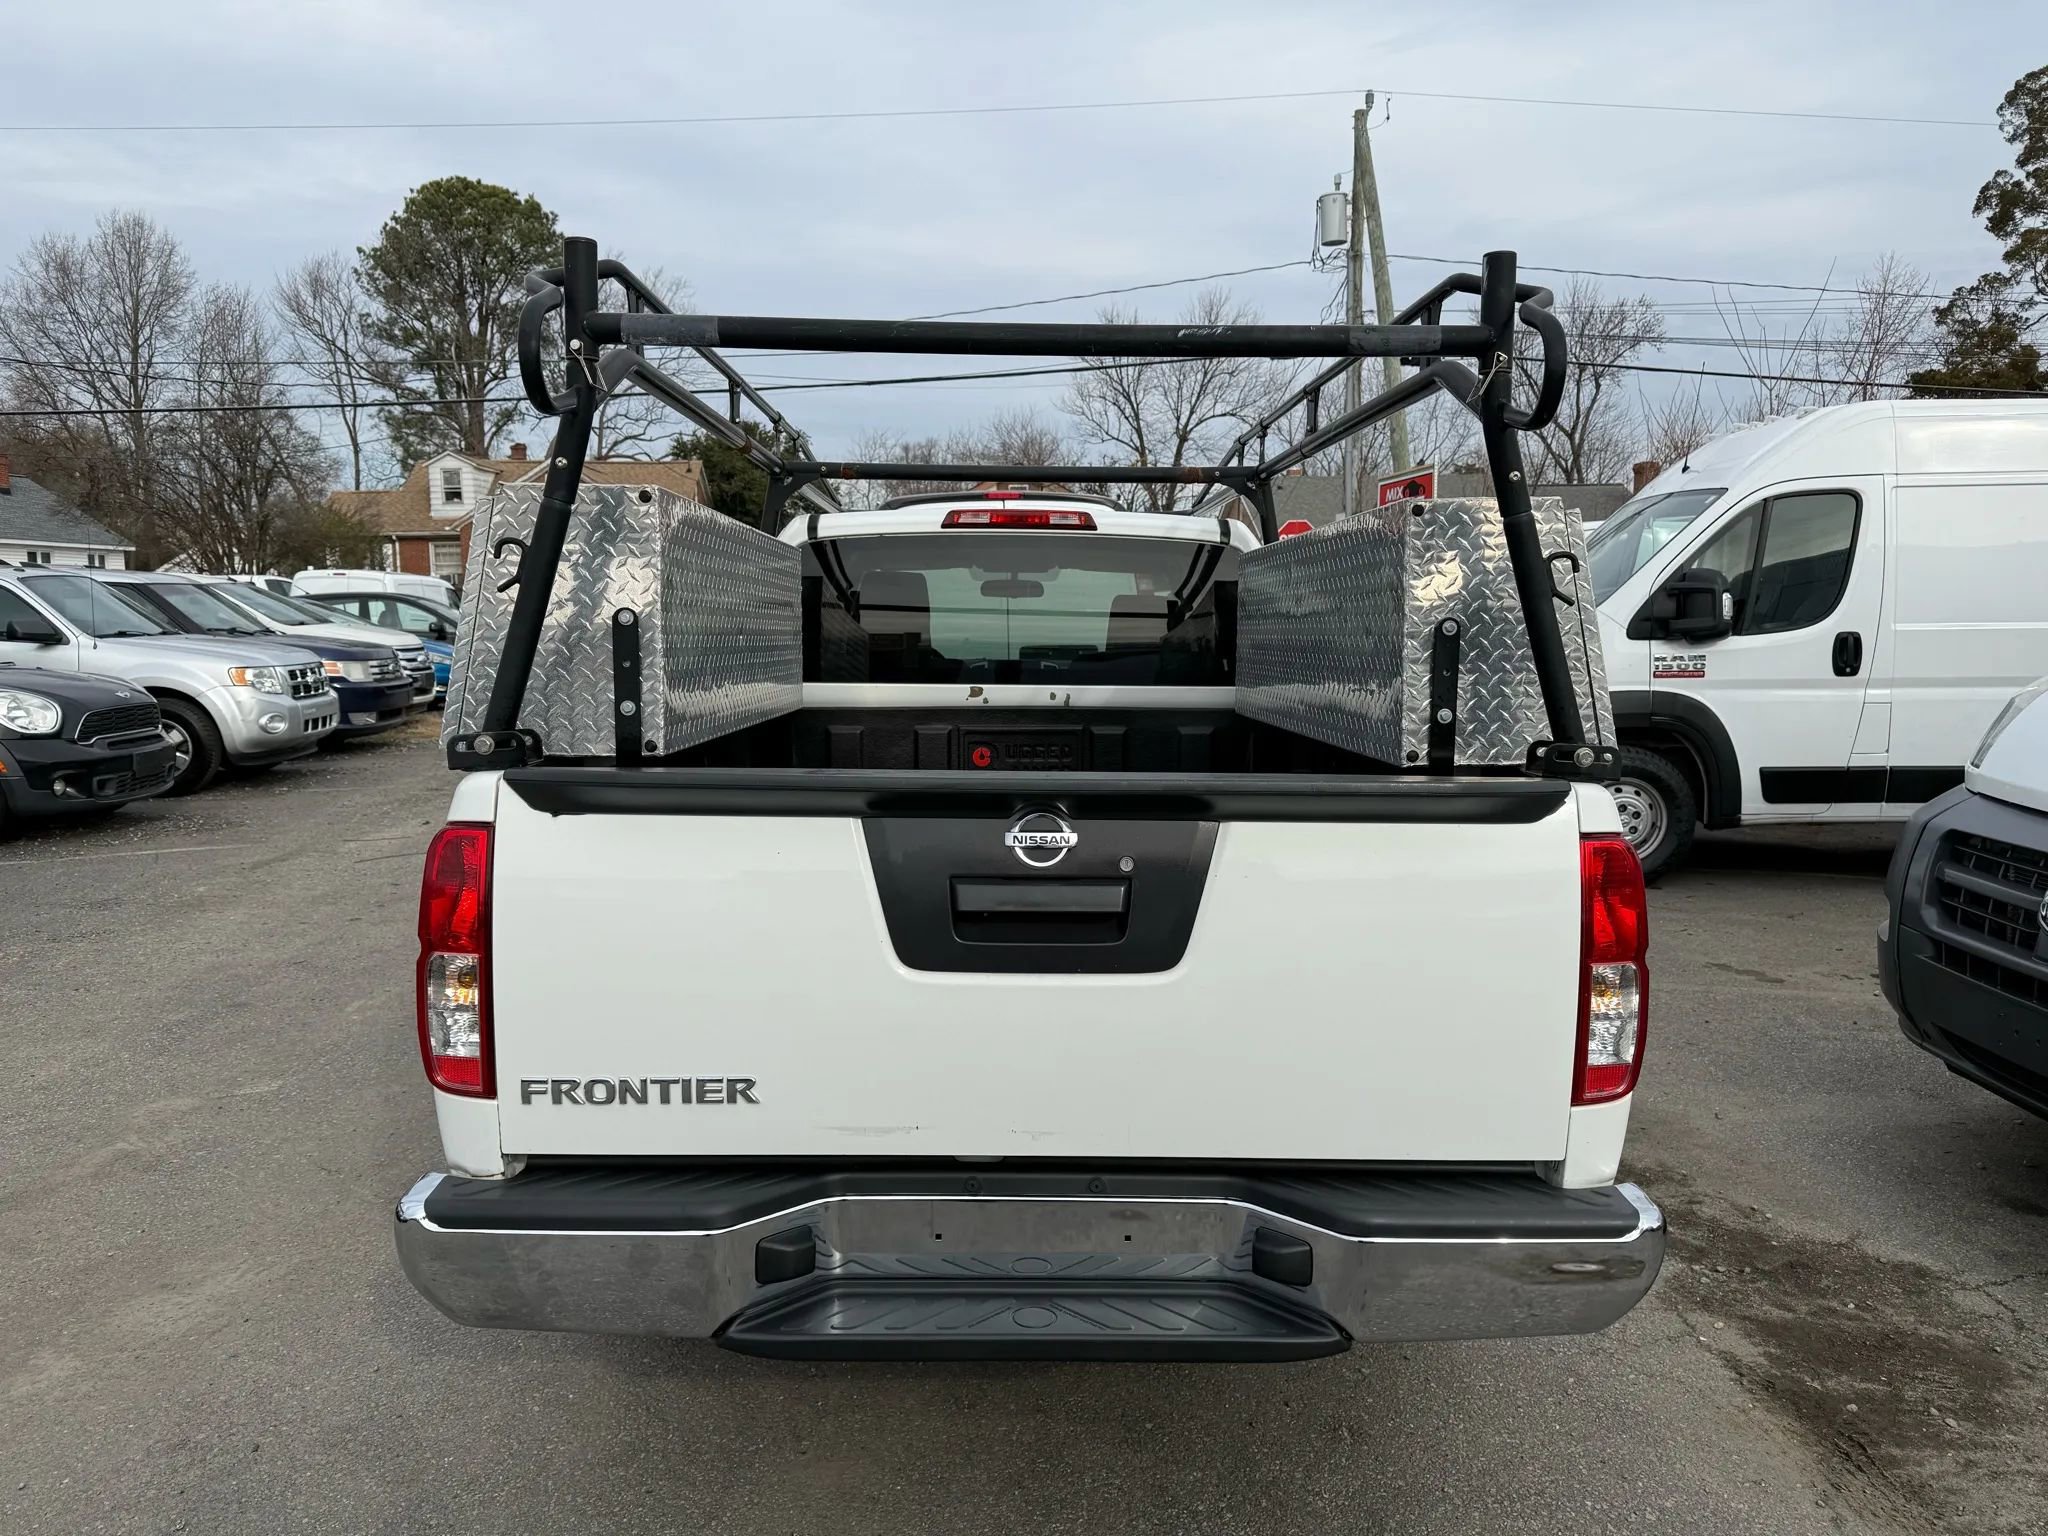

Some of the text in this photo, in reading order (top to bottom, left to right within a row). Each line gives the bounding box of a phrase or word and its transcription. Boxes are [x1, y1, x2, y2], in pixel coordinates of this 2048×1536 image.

[1385, 485, 1404, 502] MIX
[1654, 662, 1706, 670] 1500
[1012, 835, 1070, 845] NISSAN
[520, 1076, 760, 1105] FRONTIER
